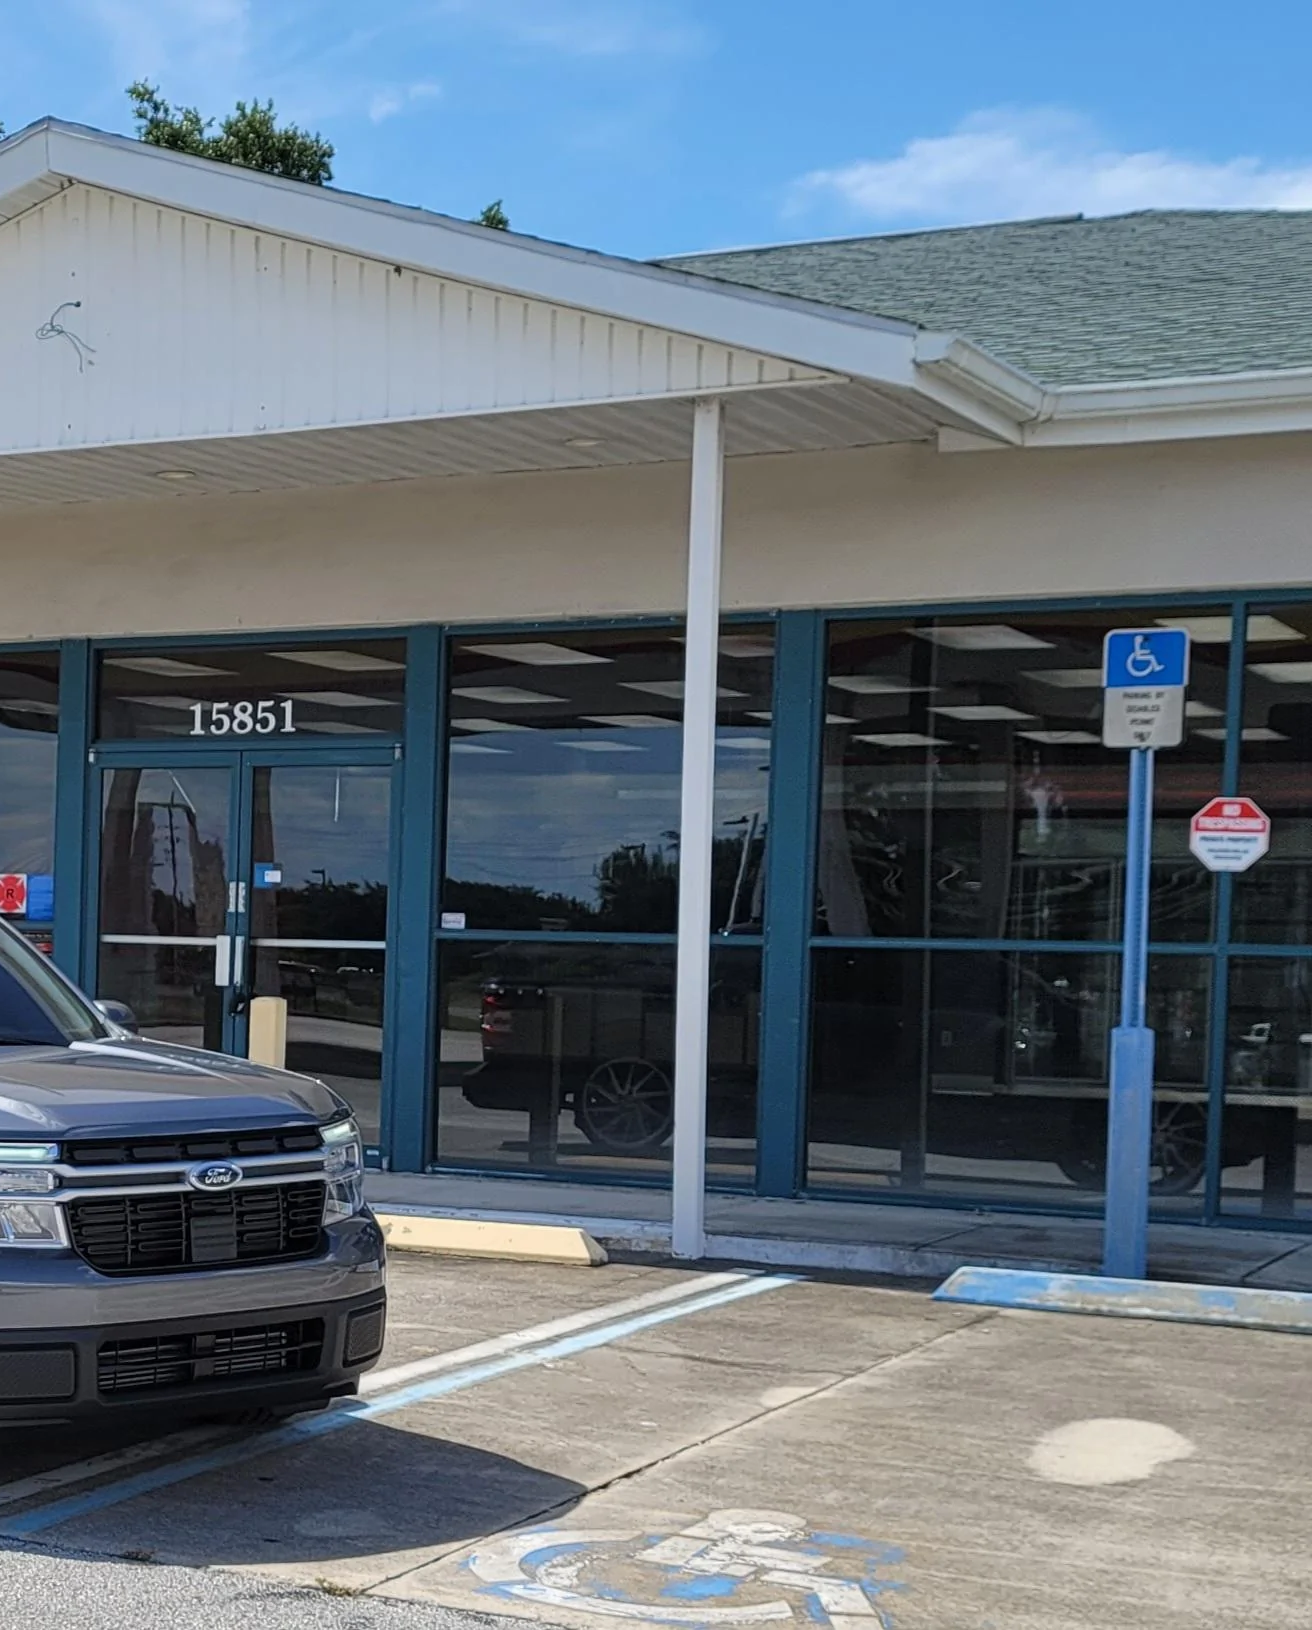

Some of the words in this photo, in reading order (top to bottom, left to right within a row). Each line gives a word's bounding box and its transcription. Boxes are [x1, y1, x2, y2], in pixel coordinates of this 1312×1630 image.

[189, 699, 296, 735] 15851
[6, 888, 15, 899] R
[205, 1168, 232, 1184] Ford
